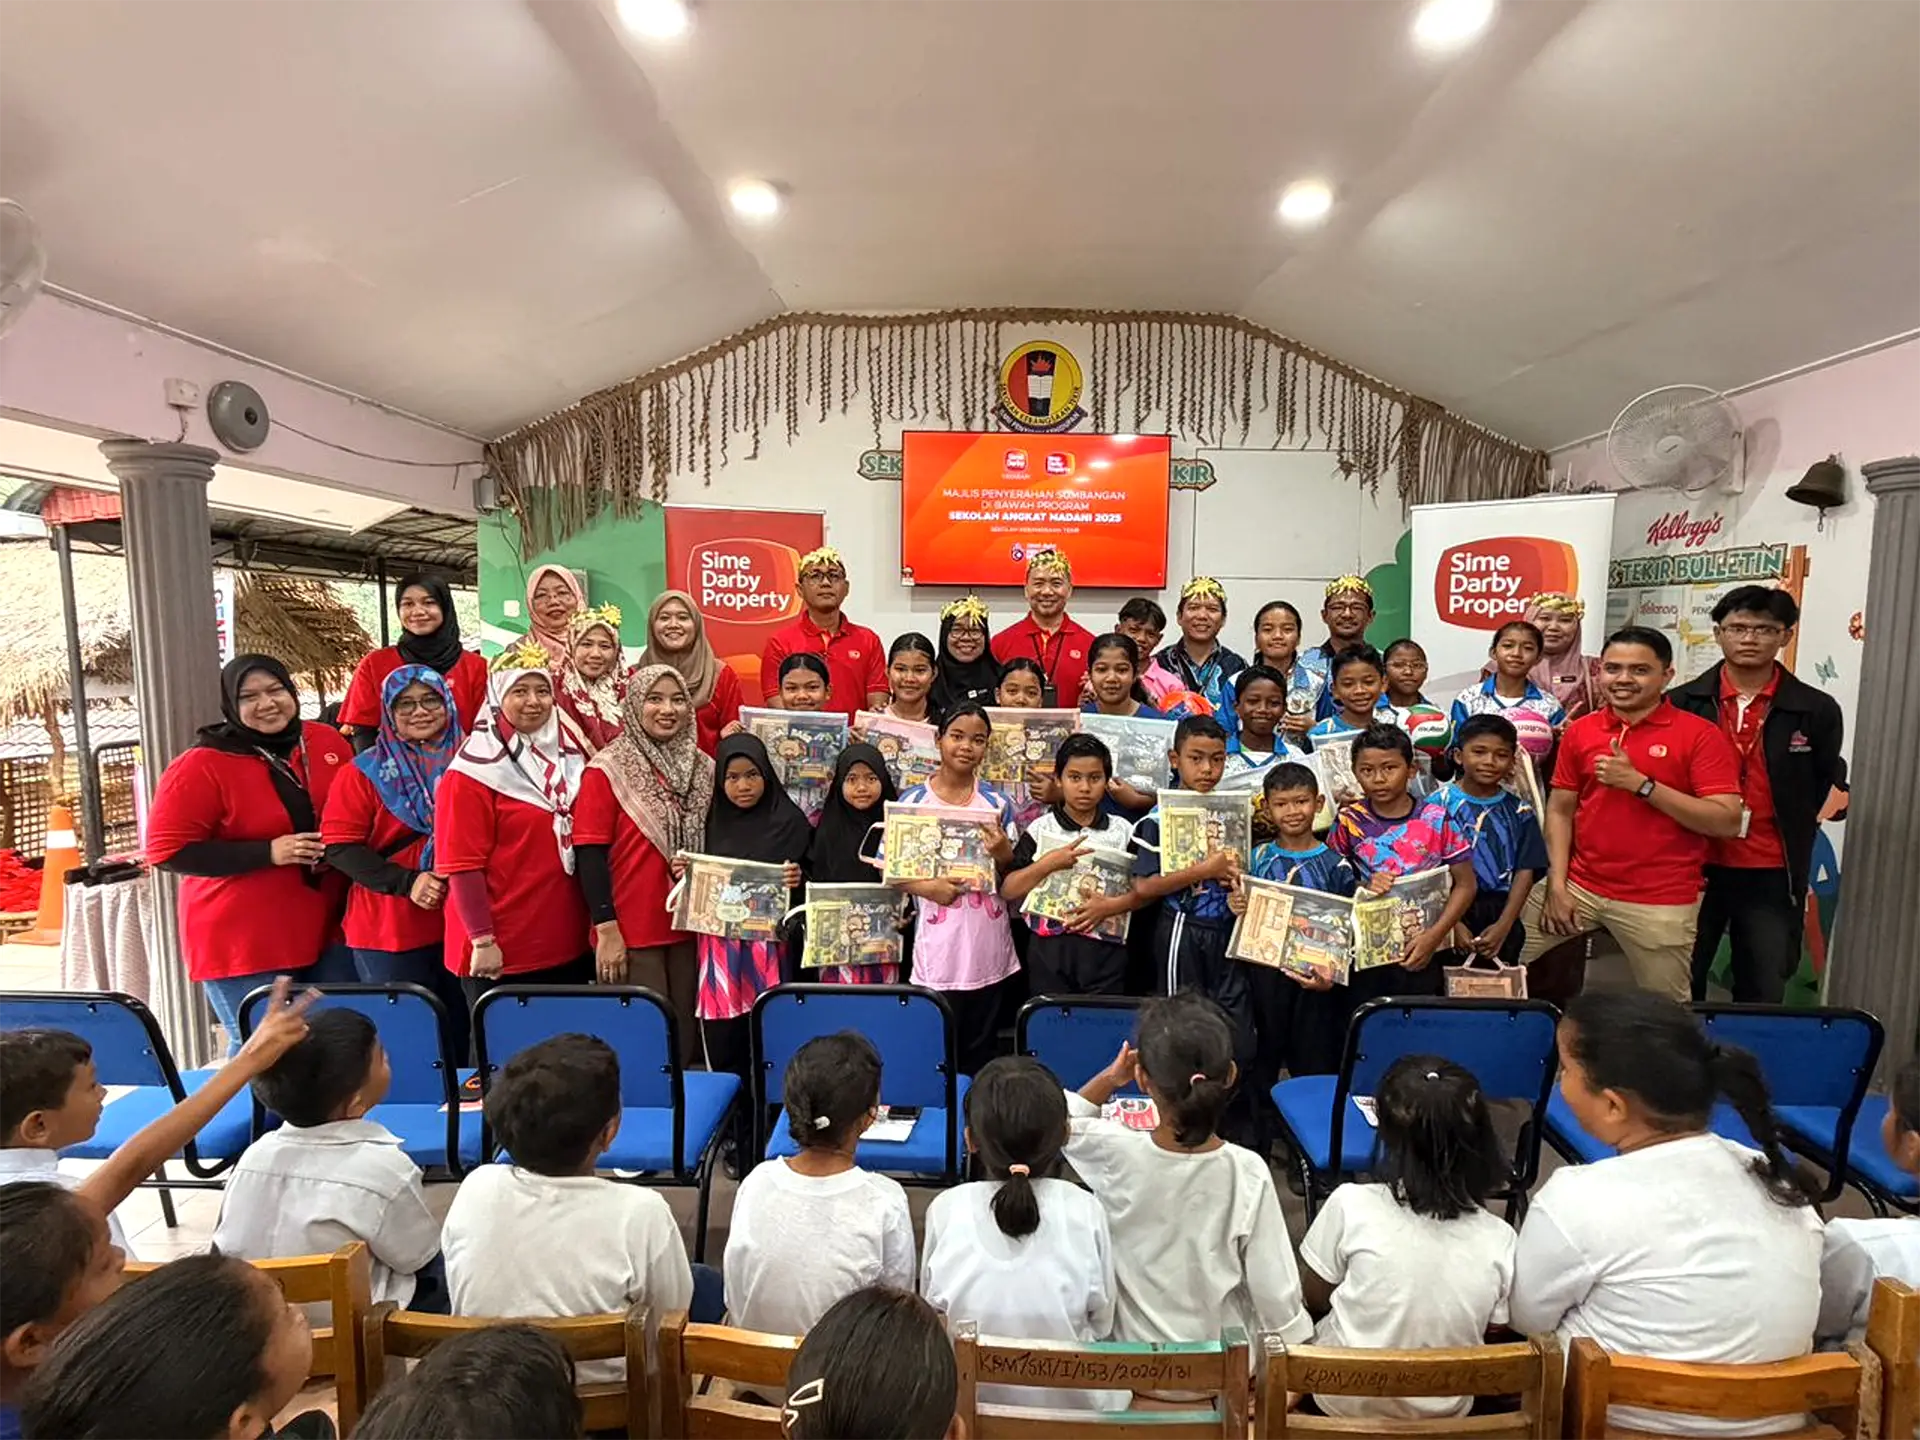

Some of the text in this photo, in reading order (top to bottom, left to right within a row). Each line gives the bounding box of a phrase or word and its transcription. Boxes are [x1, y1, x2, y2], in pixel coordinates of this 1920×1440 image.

[864, 455, 902, 473] SEK
[1174, 465, 1209, 482] KIR
[943, 489, 1126, 500] MAJLIS PENYERAHAN SUMBANGAN
[993, 501, 1034, 510] BAWAH
[1037, 502, 1090, 511] PROGRAM
[948, 511, 1122, 523] SEKOLAH ANGKAT MADANI 2025
[1646, 510, 1723, 548] Kellogg's
[701, 550, 751, 570] Sime
[1450, 552, 1510, 572] Sime
[1622, 558, 1672, 582] TEKIR
[1674, 548, 1784, 579] BULLETIN
[701, 570, 761, 592] Darby
[1450, 571, 1522, 597] Darby
[702, 588, 790, 612] Property
[1449, 594, 1531, 619] Proper
